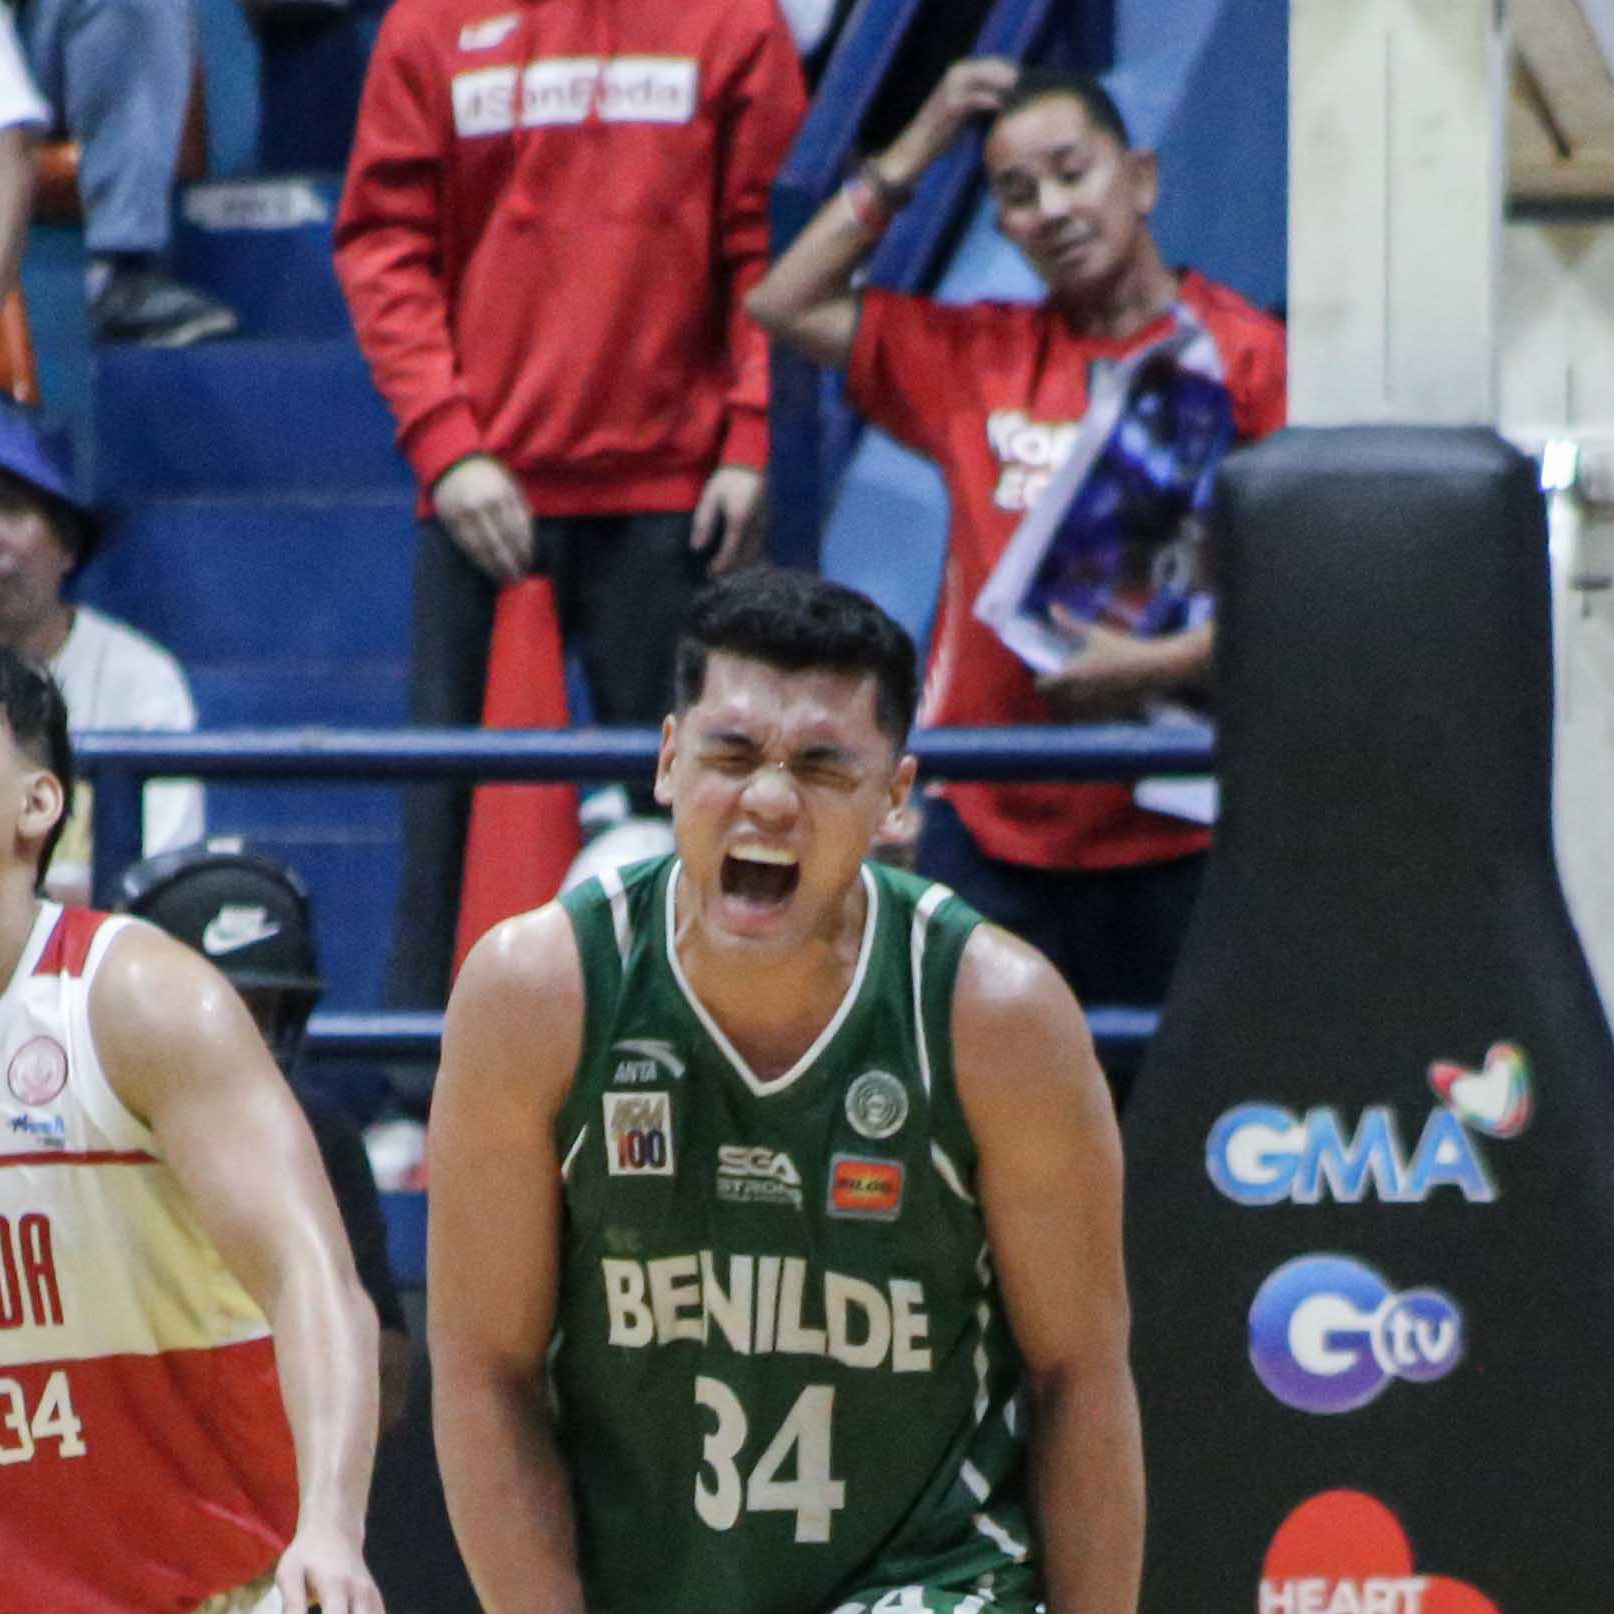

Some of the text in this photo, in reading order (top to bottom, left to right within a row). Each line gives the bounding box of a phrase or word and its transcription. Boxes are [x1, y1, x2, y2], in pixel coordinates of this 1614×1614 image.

[1205, 1101, 1496, 1206] GMA
[601, 1250, 932, 1373] BENILDE
[694, 1376, 846, 1543] 34
